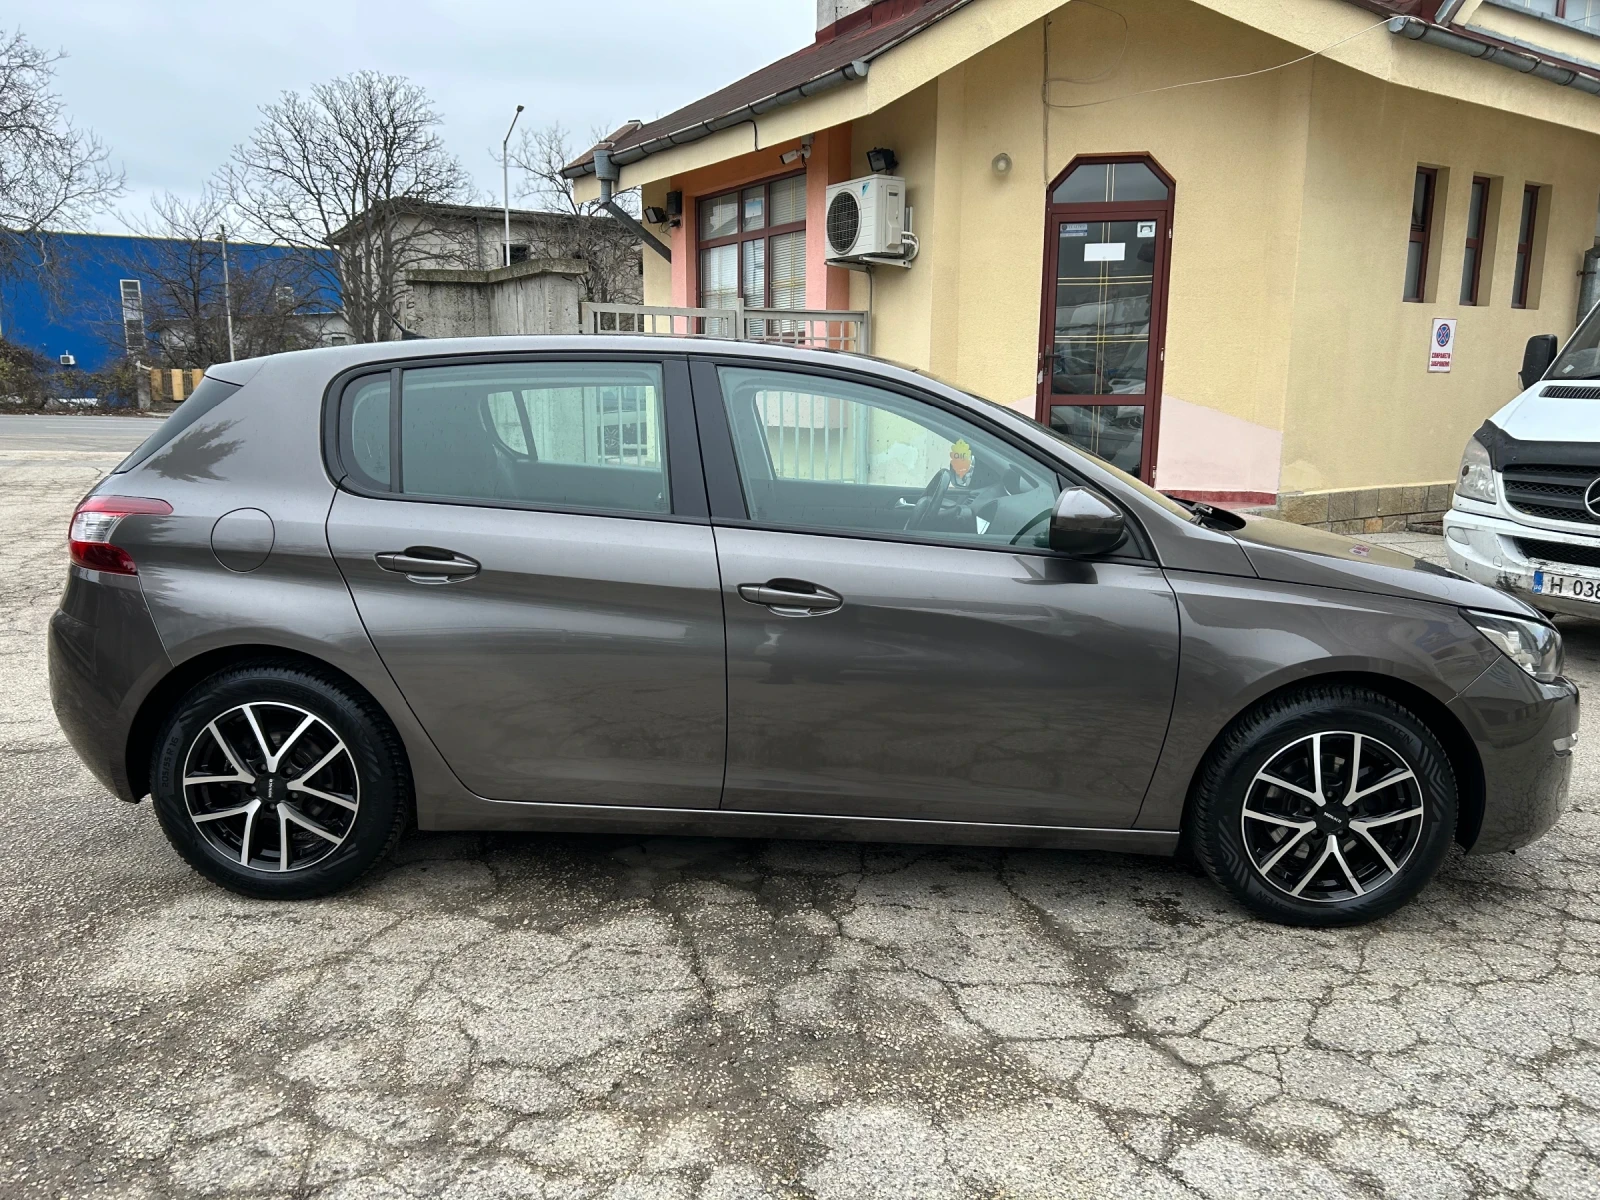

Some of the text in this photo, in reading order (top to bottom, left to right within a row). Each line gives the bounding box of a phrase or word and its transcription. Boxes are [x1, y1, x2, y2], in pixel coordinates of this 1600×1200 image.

[1550, 577, 1563, 593] H
[161, 736, 179, 788] 205/55 R 16
